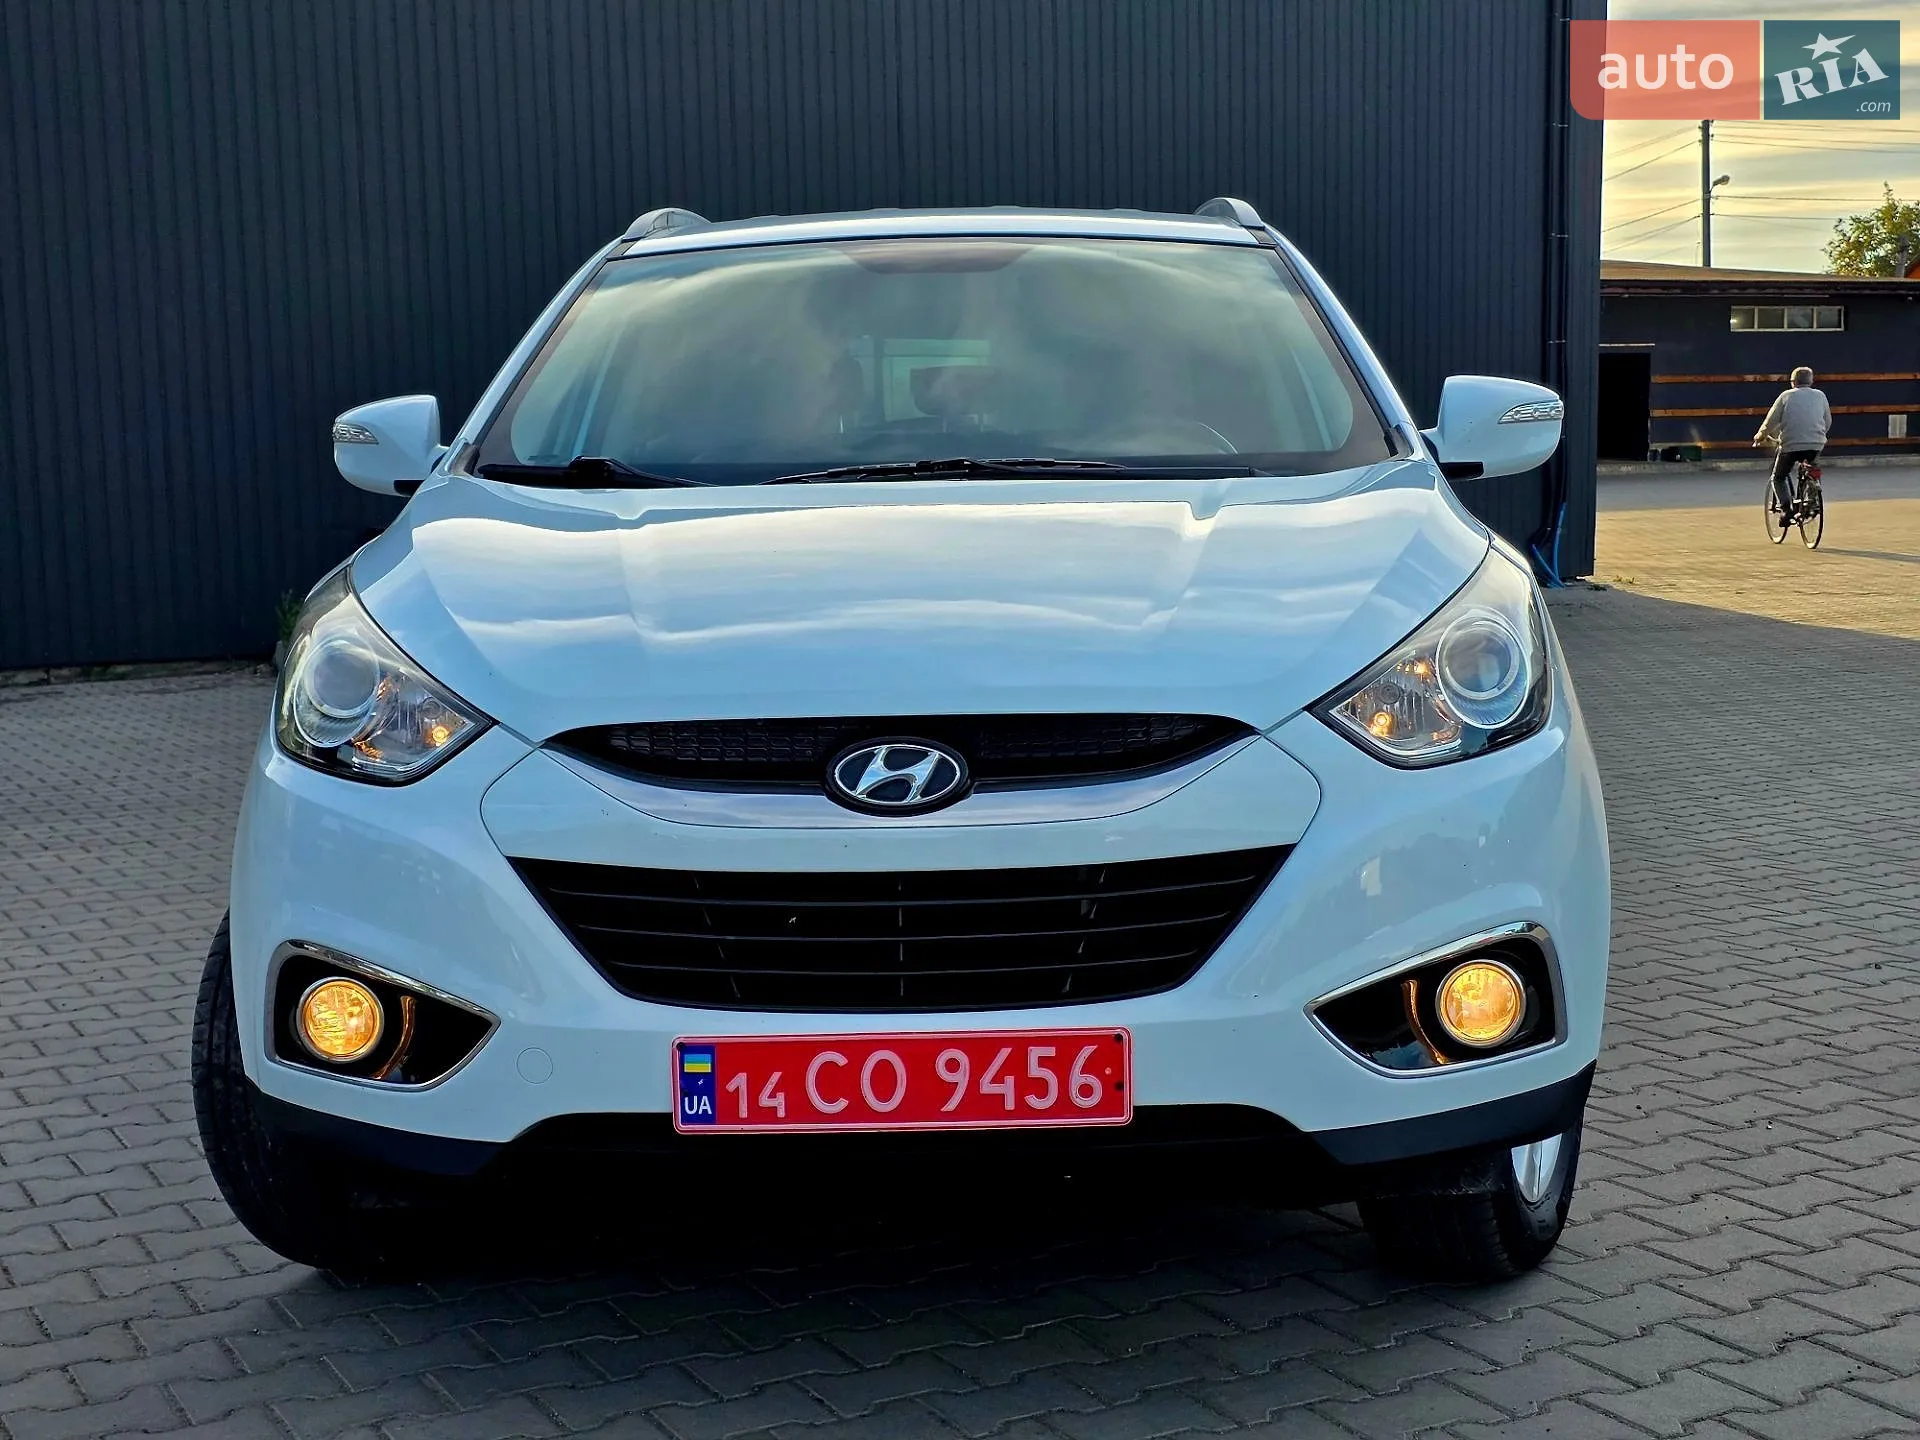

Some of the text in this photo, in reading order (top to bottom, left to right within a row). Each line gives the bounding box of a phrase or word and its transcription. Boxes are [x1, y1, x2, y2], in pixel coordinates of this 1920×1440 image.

[725, 1045, 1103, 1119] 14 CO 9456
[684, 1096, 712, 1116] UA
